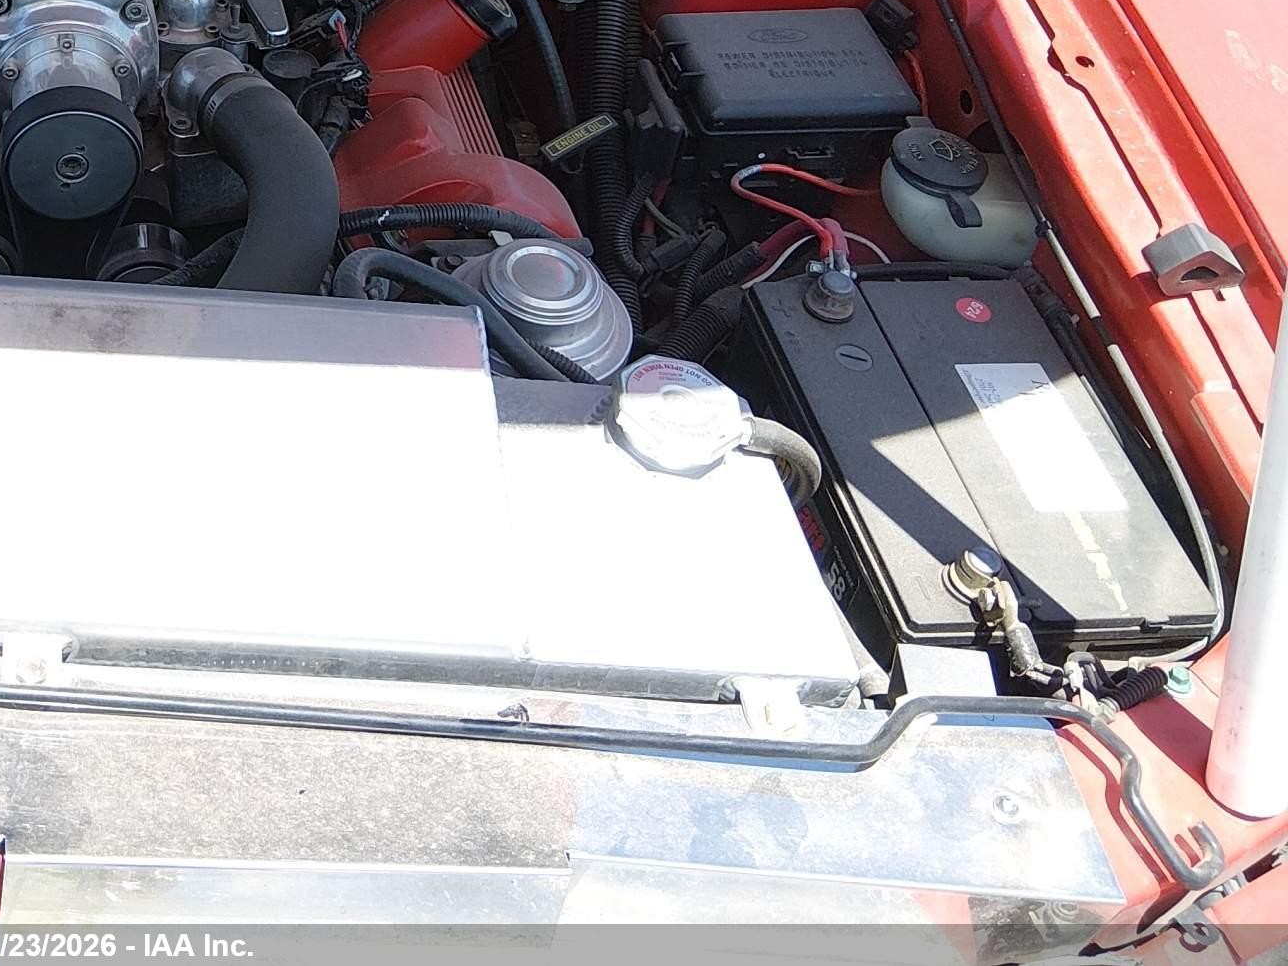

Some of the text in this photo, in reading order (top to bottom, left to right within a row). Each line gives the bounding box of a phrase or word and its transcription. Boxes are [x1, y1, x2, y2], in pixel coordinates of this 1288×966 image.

[554, 120, 605, 151] ENGINE OIL
[664, 364, 684, 373] OPEN
[685, 368, 701, 379] NOT
[701, 377, 713, 387] DO
[827, 562, 847, 601] 58
